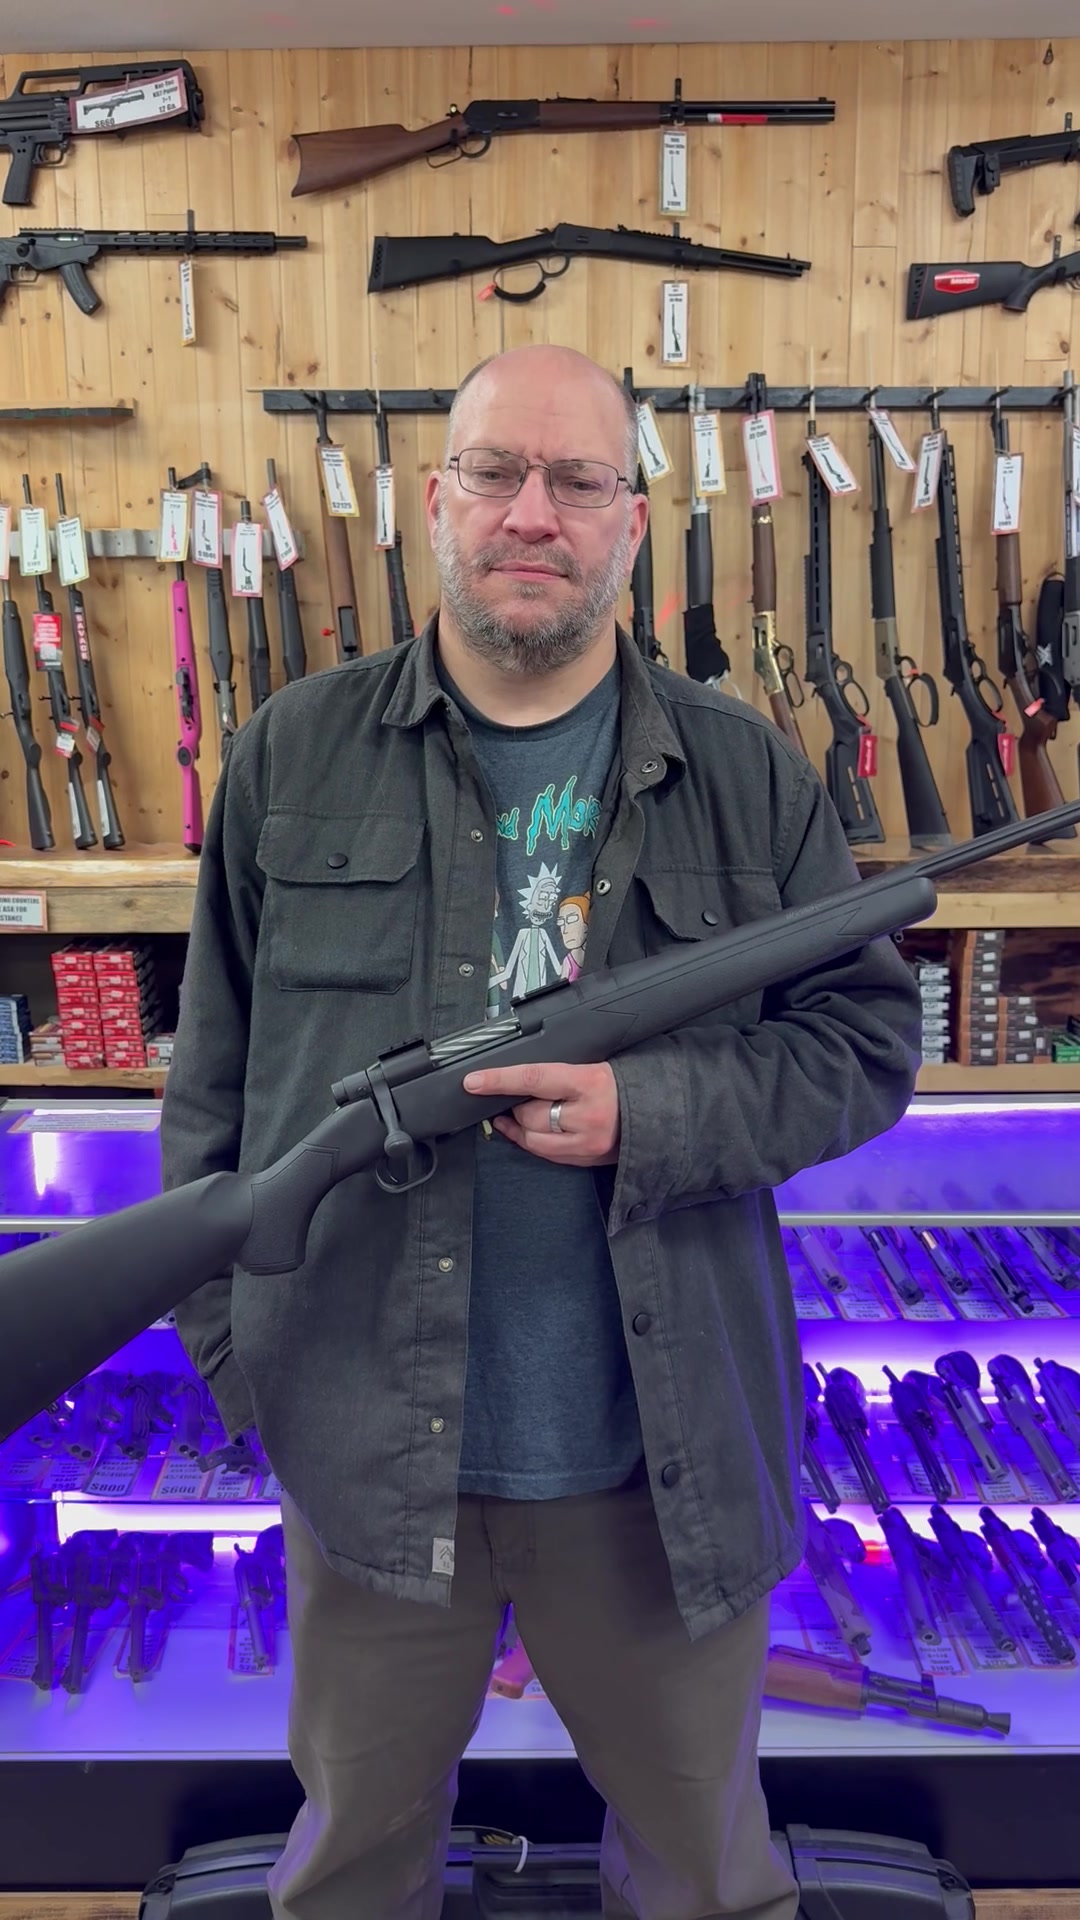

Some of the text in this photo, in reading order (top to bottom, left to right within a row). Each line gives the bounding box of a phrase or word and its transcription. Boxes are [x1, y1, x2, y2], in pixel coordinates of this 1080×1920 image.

[75, 614, 88, 660] SAVAGE
[91, 1483, 125, 1492] $800
[161, 1486, 195, 1494] $600
